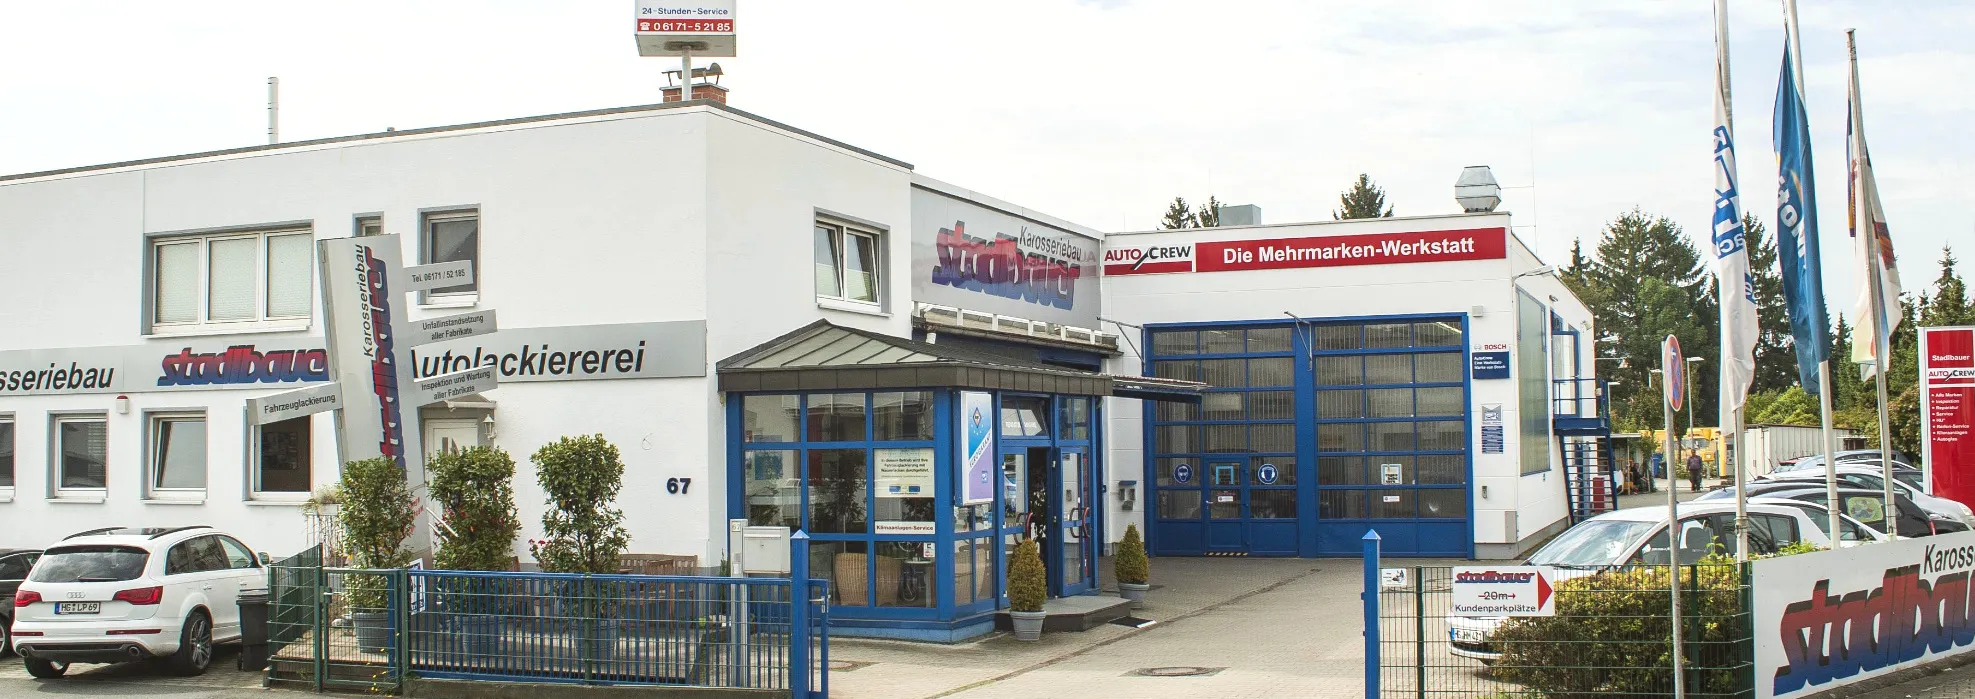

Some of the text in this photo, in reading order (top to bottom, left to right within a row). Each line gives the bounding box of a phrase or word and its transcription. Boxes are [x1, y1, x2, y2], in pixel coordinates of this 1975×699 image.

[1020, 225, 1082, 261] Karosseriebau
[1223, 236, 1474, 265] Die Mehrmarken-Werkstatt
[1103, 248, 1140, 262] AUTO
[1148, 244, 1191, 260] CREW
[355, 244, 374, 358] Karosseriebau
[422, 314, 484, 331] Unfallinstandsetzung
[431, 326, 472, 340] aller Fabrikate
[421, 370, 491, 391] Inspektion und Wartung
[434, 384, 475, 400] aller Fabrikate
[264, 394, 336, 414] Fahrzeuglackierung
[667, 477, 692, 494] 67
[1484, 591, 1508, 601] 20m
[1455, 603, 1537, 613] Kundenparkplätze
